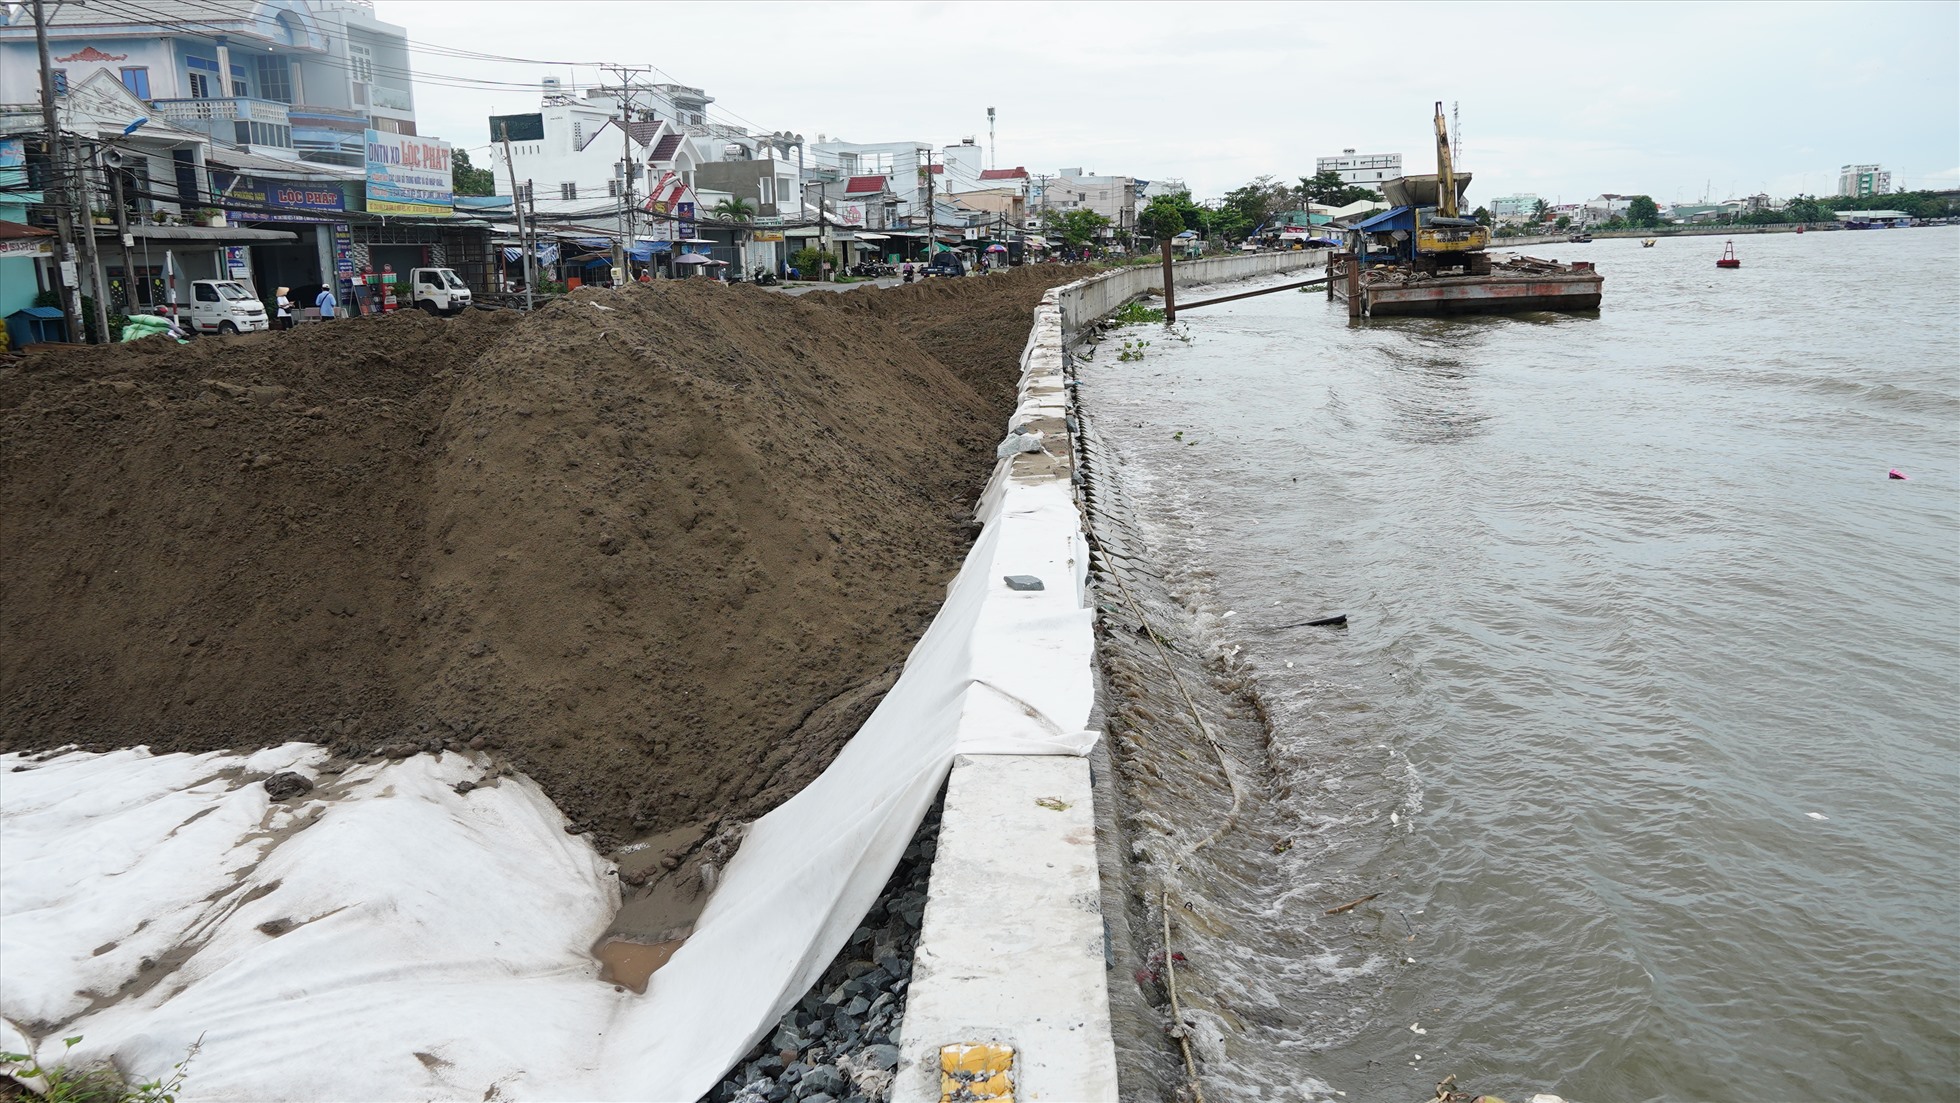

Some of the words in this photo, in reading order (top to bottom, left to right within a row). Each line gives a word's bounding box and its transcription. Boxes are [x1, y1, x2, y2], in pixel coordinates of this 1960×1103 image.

[368, 143, 388, 164] DNTN
[390, 146, 400, 165] XD
[401, 141, 421, 171] LỘC
[422, 143, 449, 171] PHÁT
[278, 188, 304, 205] LỘC
[305, 189, 338, 205] PHÁT
